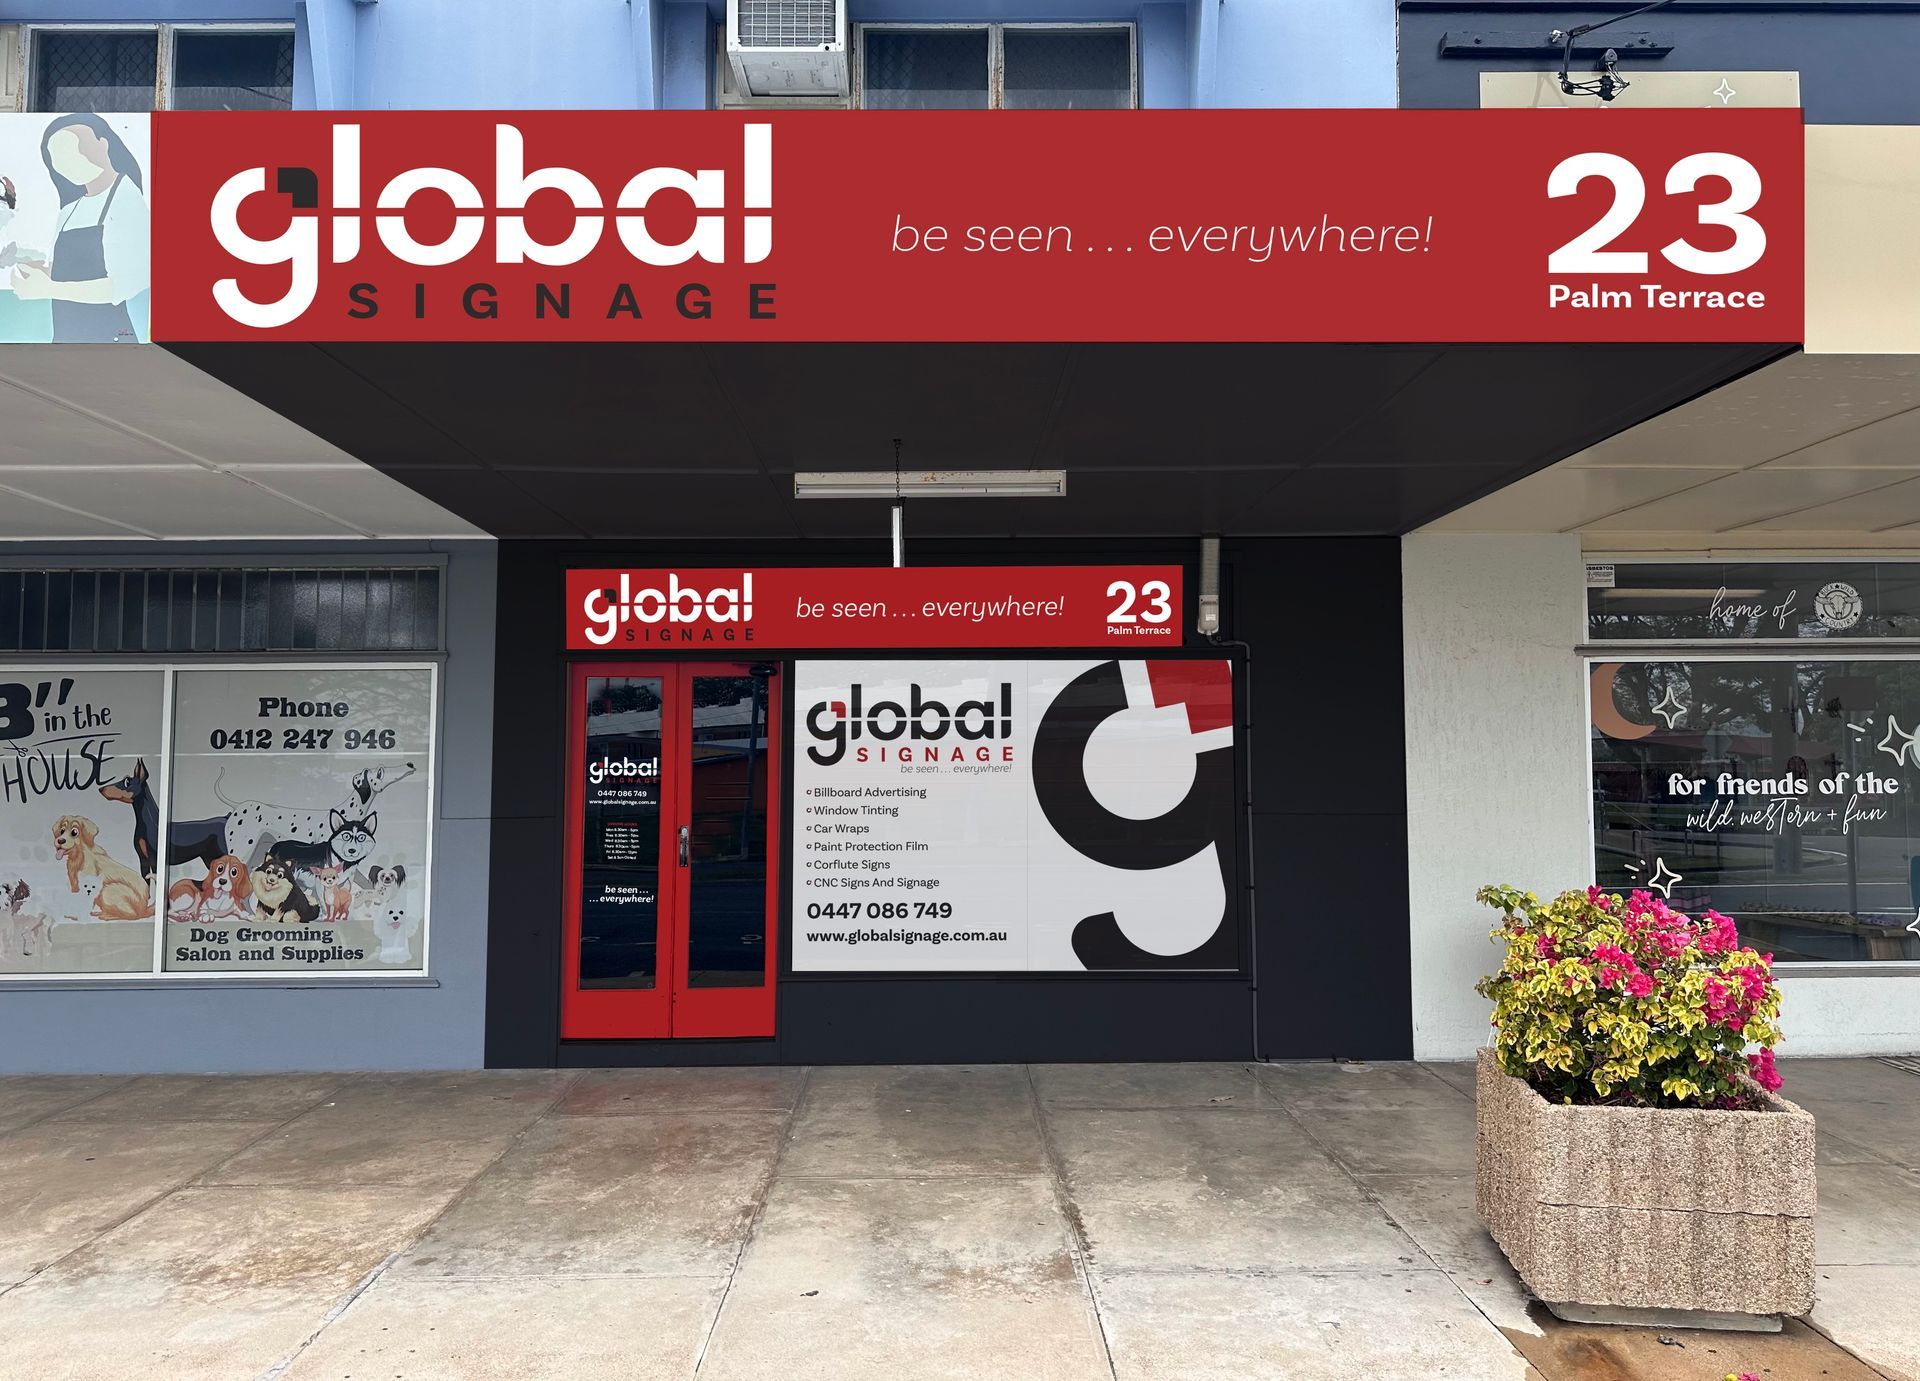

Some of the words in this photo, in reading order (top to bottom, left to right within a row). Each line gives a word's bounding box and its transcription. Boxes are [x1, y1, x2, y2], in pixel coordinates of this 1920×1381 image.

[1547, 152, 1767, 275] 23
[210, 124, 772, 328] global
[893, 214, 947, 252] be
[963, 225, 1072, 252] seen
[1149, 214, 1433, 262] everywhere!
[348, 283, 777, 319] SIGNAGE
[1550, 284, 1632, 308] Palm
[1640, 284, 1766, 308] Terrace
[584, 573, 752, 645] global
[796, 597, 824, 618] be
[832, 603, 887, 618] seen
[922, 595, 1064, 622] everywhere!
[1106, 580, 1172, 623] 23
[1709, 586, 1767, 619] home
[1772, 590, 1797, 630] of
[626, 628, 754, 642] SIGNAGE
[1107, 626, 1132, 635] Palm
[1134, 626, 1171, 635] Terrace
[44, 712, 66, 732] in
[72, 704, 112, 729] the
[258, 697, 350, 718] Phone
[806, 683, 1012, 766] global
[209, 728, 272, 750] 0412
[283, 728, 334, 750] 247
[344, 728, 396, 750] 946
[857, 747, 1014, 763] SIGNAGE
[3, 739, 116, 803] HOUSE
[589, 756, 658, 784] global
[900, 763, 914, 774] be
[916, 766, 939, 774] seen
[953, 763, 1012, 775] everywhere!
[814, 787, 862, 798] Billboard
[864, 786, 927, 799] Advertising
[1668, 773, 1706, 795] for
[1717, 772, 1808, 795] friends
[1818, 772, 1850, 795] of
[1854, 771, 1899, 794] the
[814, 805, 859, 816] Window
[861, 805, 899, 818] Tinting
[1843, 794, 1886, 835] fun
[814, 823, 833, 834] Car
[835, 823, 870, 836] Wraps
[814, 841, 843, 852] Paint
[845, 841, 903, 852] Protection
[905, 841, 929, 852] Film
[814, 859, 859, 870] Corflute
[861, 859, 891, 872] Signs
[605, 885, 616, 894] be
[814, 877, 838, 888] CNC
[841, 877, 870, 890] Signs
[872, 877, 894, 888] And
[896, 877, 940, 890] Signage
[807, 902, 861, 919] 0447
[866, 902, 908, 919] 086
[913, 902, 953, 919] 749
[190, 928, 230, 944] Dog
[236, 927, 334, 943] Grooming
[807, 928, 1007, 945] www.globalsignage.com.au
[175, 947, 232, 962] Salon
[238, 947, 274, 961] and
[281, 945, 364, 963] Supplies
